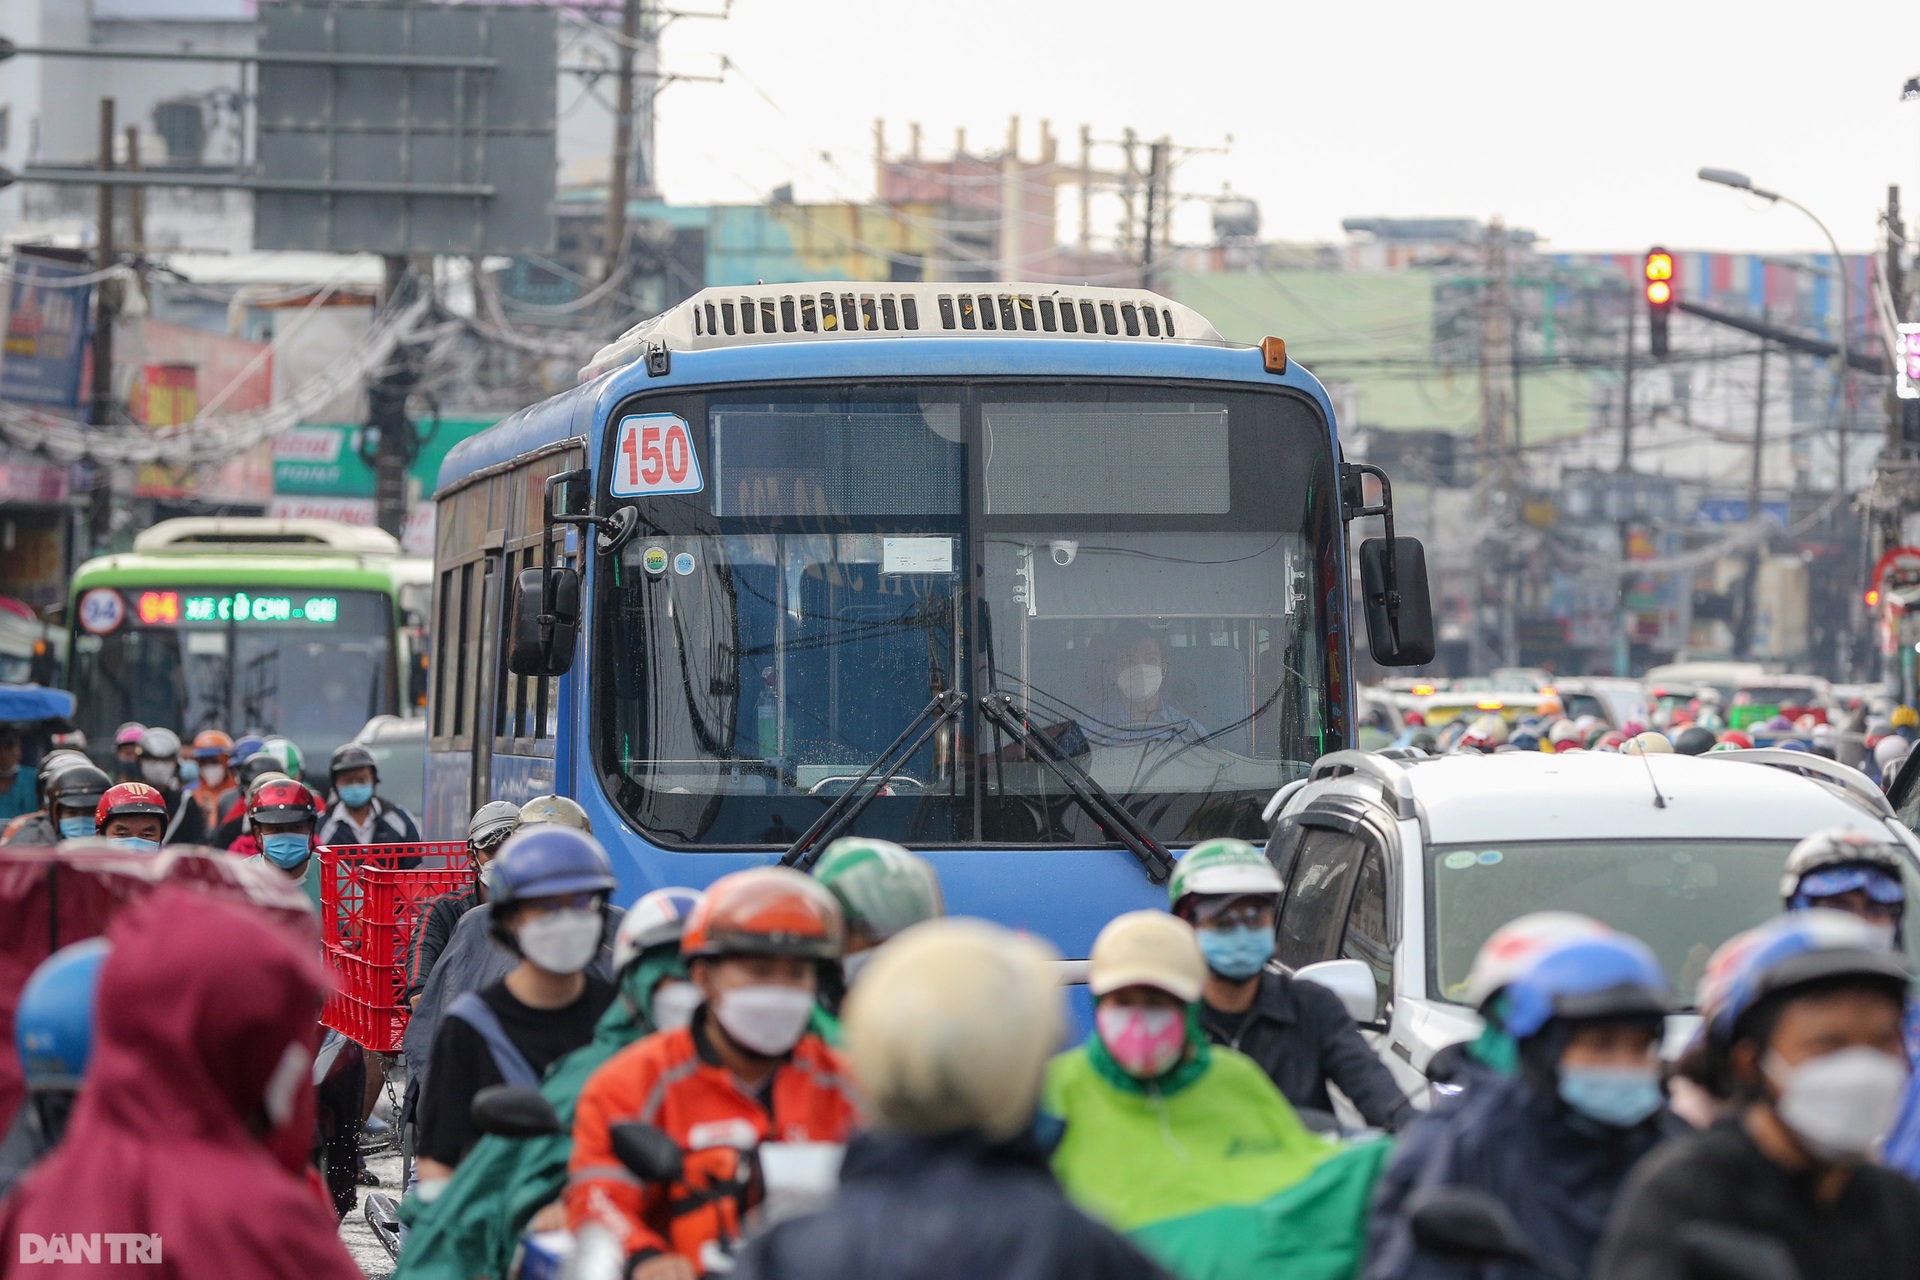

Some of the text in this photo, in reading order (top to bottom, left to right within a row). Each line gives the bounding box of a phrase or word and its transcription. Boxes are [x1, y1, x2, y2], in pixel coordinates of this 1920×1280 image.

[623, 425, 689, 486] 150
[646, 556, 663, 564] 05/22
[85, 600, 116, 620] 94
